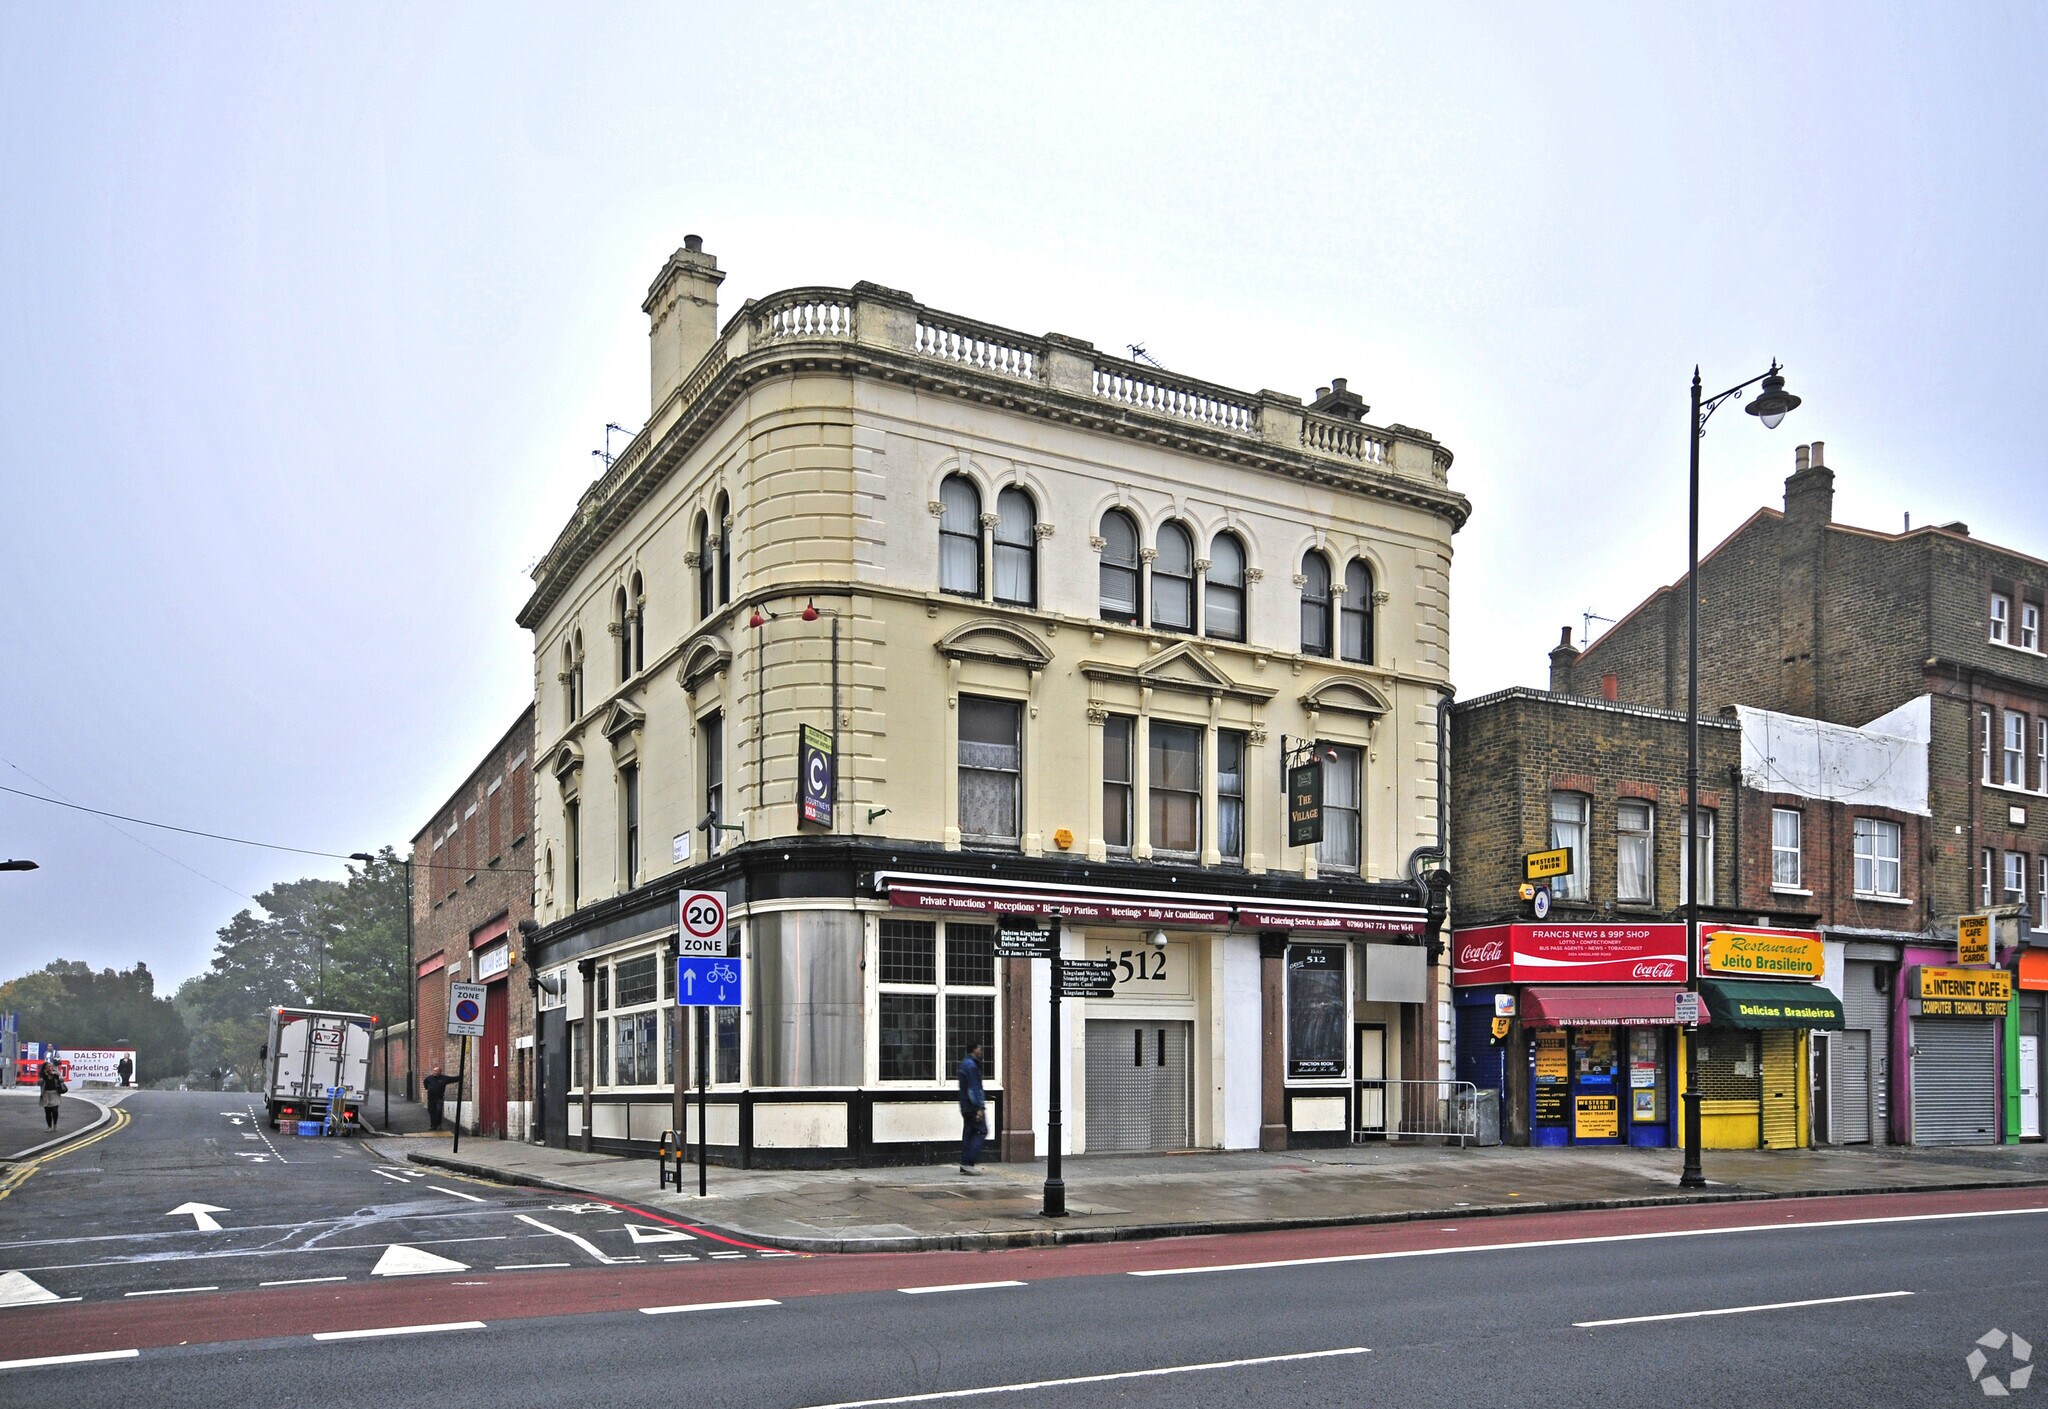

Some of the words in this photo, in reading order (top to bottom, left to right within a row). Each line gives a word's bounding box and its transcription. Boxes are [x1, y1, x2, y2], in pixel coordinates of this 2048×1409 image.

[1297, 795, 1312, 806] THE
[805, 805, 816, 818] SOLD
[1292, 808, 1318, 822] VILLAGE
[1530, 856, 1560, 867] WESTERN
[1540, 862, 1560, 871] UNION
[920, 896, 947, 906] Private
[948, 897, 986, 909] Functions
[994, 901, 1034, 913] Receptions
[1074, 906, 1098, 916] Parties
[1111, 907, 1141, 919] Meetings
[1148, 908, 1162, 919] fully
[1163, 910, 1174, 919] Air
[1175, 911, 1214, 921] Conditioned
[689, 907, 718, 925] 20
[1260, 916, 1270, 924] full
[1270, 917, 1294, 927] Catering
[1295, 917, 1315, 926] Service
[1316, 918, 1341, 927] Available
[1388, 923, 1399, 931] Free
[1960, 918, 1988, 928] INTERNET
[1532, 930, 1570, 938] FRANCIS
[1572, 930, 1598, 938] NEWS
[1600, 930, 1606, 938] &
[1608, 930, 1625, 938] 99P
[1626, 930, 1650, 938] SHOP
[1965, 928, 1982, 937] CAFE
[685, 940, 722, 951] ZONE
[1730, 937, 1809, 954] Restaurant
[1960, 945, 1988, 954] CALLING
[1461, 940, 1504, 964] Coca-Cola
[1721, 954, 1752, 968] Jeito
[1756, 956, 1813, 972] Brasileiro
[1963, 953, 1985, 963] CARDS
[1118, 950, 1167, 983] 512
[1632, 962, 1676, 978] Coca-Cola
[453, 984, 485, 993] Controlled
[1934, 979, 1976, 996] INTERNET
[1978, 981, 2001, 997] CAFE
[457, 992, 480, 1000] ZONE
[1739, 1004, 1780, 1017] Delicias
[1784, 1007, 1836, 1018] Brasileiras
[1922, 1001, 1952, 1014] COMPUTER
[1954, 1001, 1983, 1015] TECHNICAL
[1985, 1002, 2007, 1016] SERVICE
[1621, 1017, 1679, 1025] LOTTERY-WESTER
[314, 1032, 323, 1042] A
[331, 1033, 339, 1043] Z
[69, 1064, 109, 1073] Marketing
